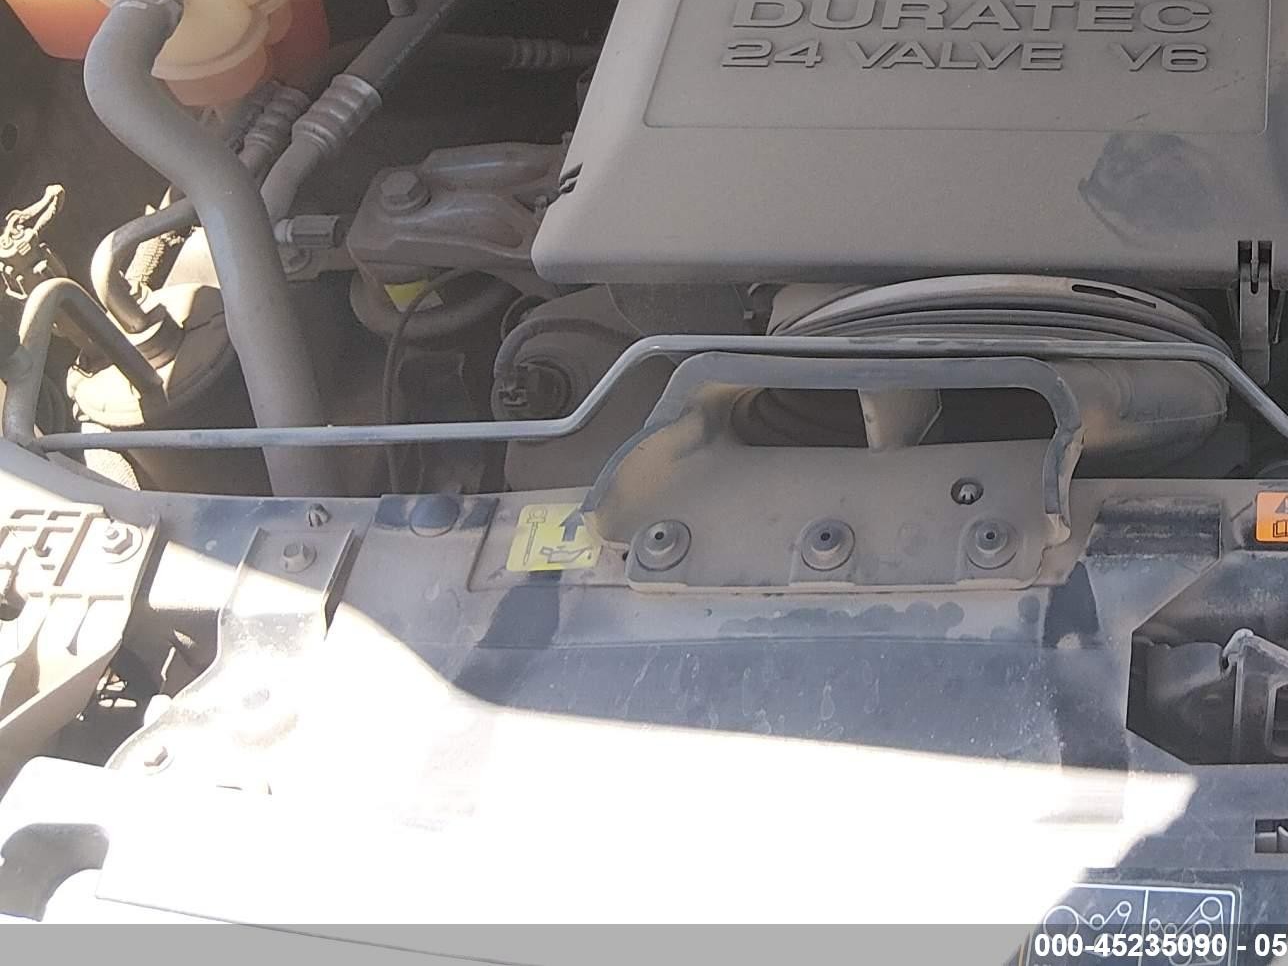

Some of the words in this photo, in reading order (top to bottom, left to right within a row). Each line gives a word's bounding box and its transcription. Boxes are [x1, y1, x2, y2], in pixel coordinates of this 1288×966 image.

[721, 39, 823, 68] 24
[849, 40, 1064, 71] VALVE
[1116, 42, 1209, 72] V6
